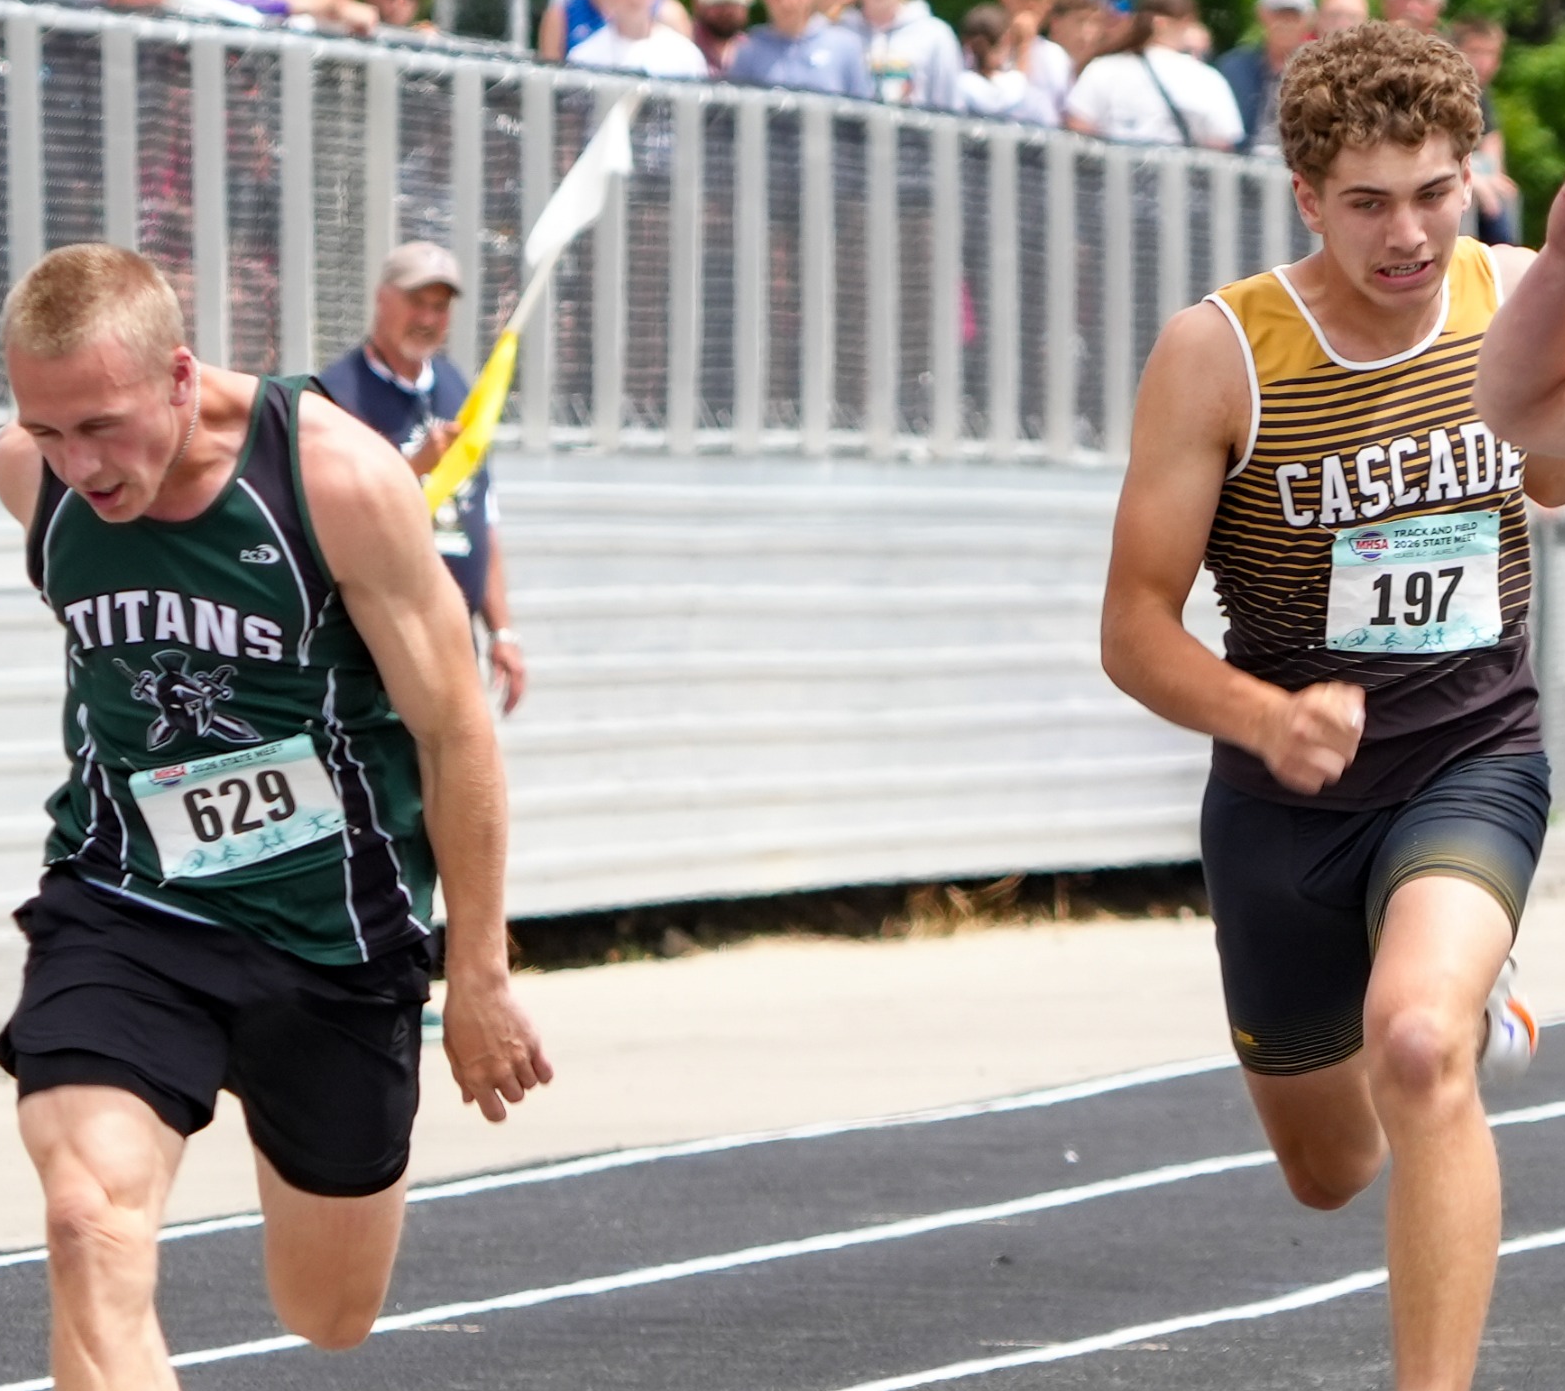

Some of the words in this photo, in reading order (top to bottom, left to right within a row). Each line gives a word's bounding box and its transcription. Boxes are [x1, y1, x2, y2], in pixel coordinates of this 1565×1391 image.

[1275, 421, 1521, 517] CASCADE
[1356, 538, 1389, 550] MHSA
[1393, 527, 1428, 538] TRACK
[1433, 525, 1452, 535] AND
[1455, 522, 1478, 532] FIELD
[1393, 539, 1420, 549] 2026
[1422, 536, 1451, 547] STATE
[1454, 533, 1477, 544] MEET
[64, 589, 283, 662] TITANS
[1370, 566, 1464, 626] 197
[183, 770, 296, 842] 629
